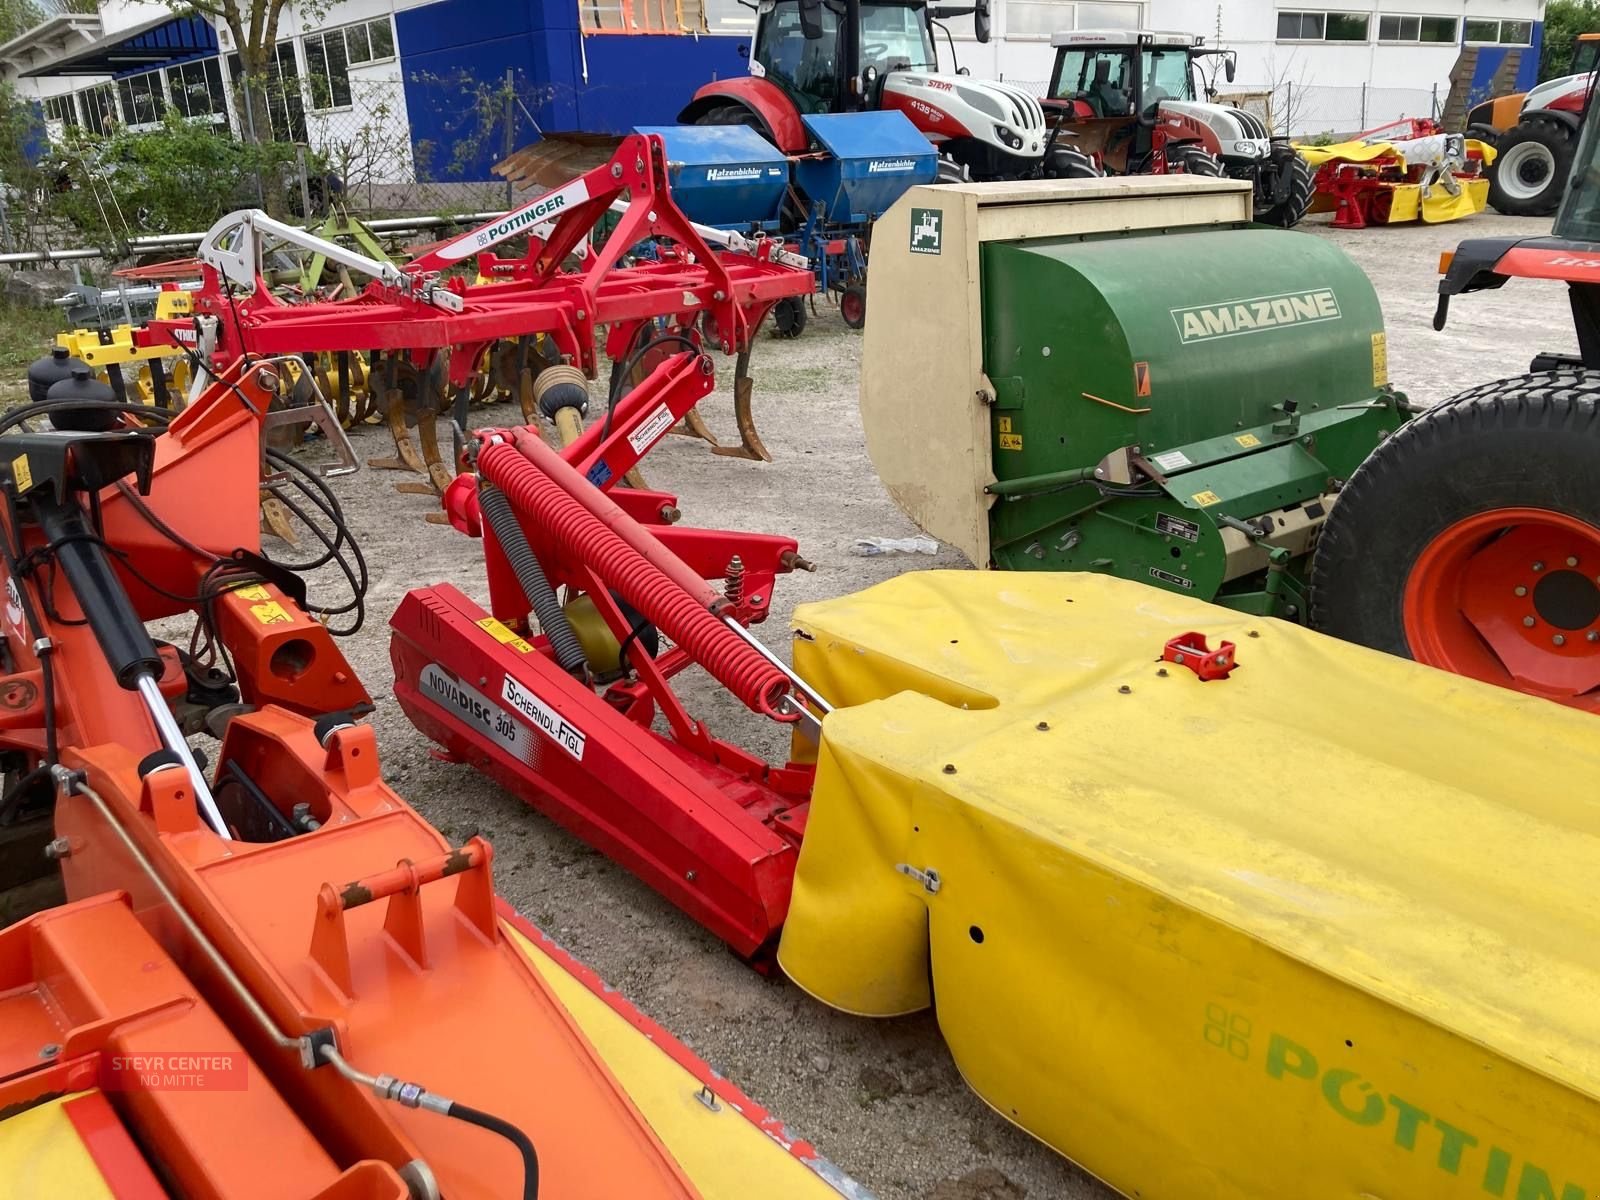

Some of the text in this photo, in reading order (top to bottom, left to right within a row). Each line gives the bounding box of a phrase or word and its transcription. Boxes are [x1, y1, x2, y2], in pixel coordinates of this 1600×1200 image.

[928, 80, 953, 91] STEYR
[911, 101, 931, 115] 4135
[869, 160, 916, 173] Hatzenbichler
[707, 168, 762, 181] Hatzenbichler
[489, 195, 565, 241] PÖTTINGER
[910, 246, 941, 254] AMAZONE
[1183, 291, 1338, 339] AMAZONE
[430, 671, 516, 741] NOVADISC 305
[506, 678, 584, 756] SCHERNDL-FIGL
